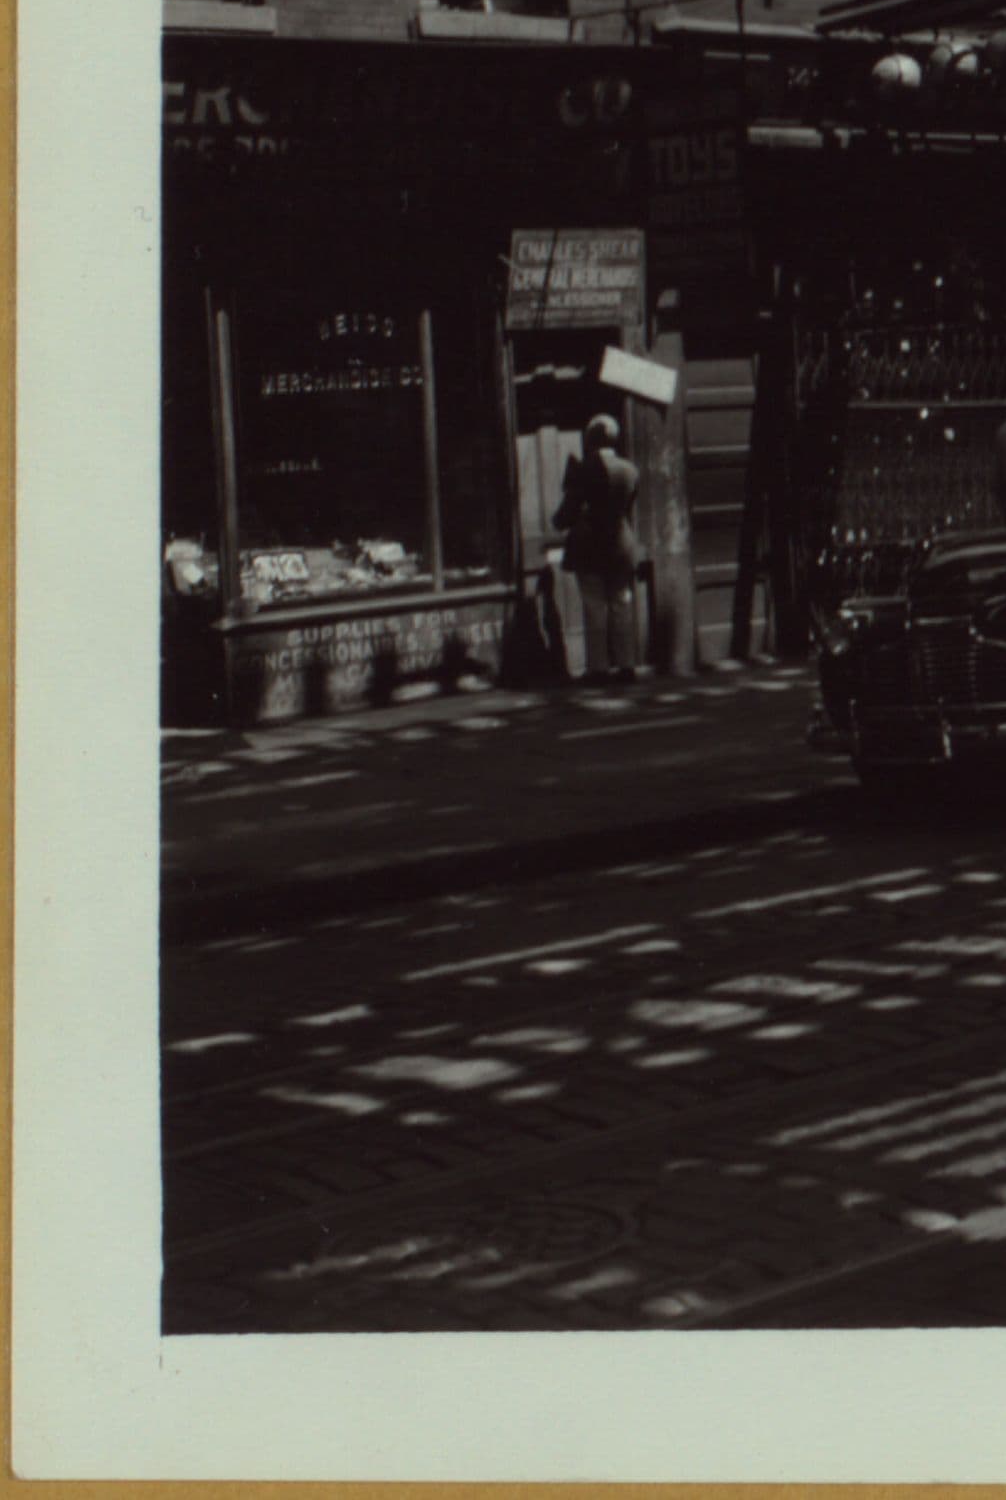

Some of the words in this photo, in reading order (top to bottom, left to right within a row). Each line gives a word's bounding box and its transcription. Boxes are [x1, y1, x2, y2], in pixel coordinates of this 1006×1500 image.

[649, 126, 737, 185] TOYS
[518, 240, 587, 262] CHALES
[513, 267, 570, 291] GENRAL
[260, 366, 392, 396] MERCHANDISE
[287, 614, 402, 647] SUPPLIES
[412, 609, 457, 629] FOR
